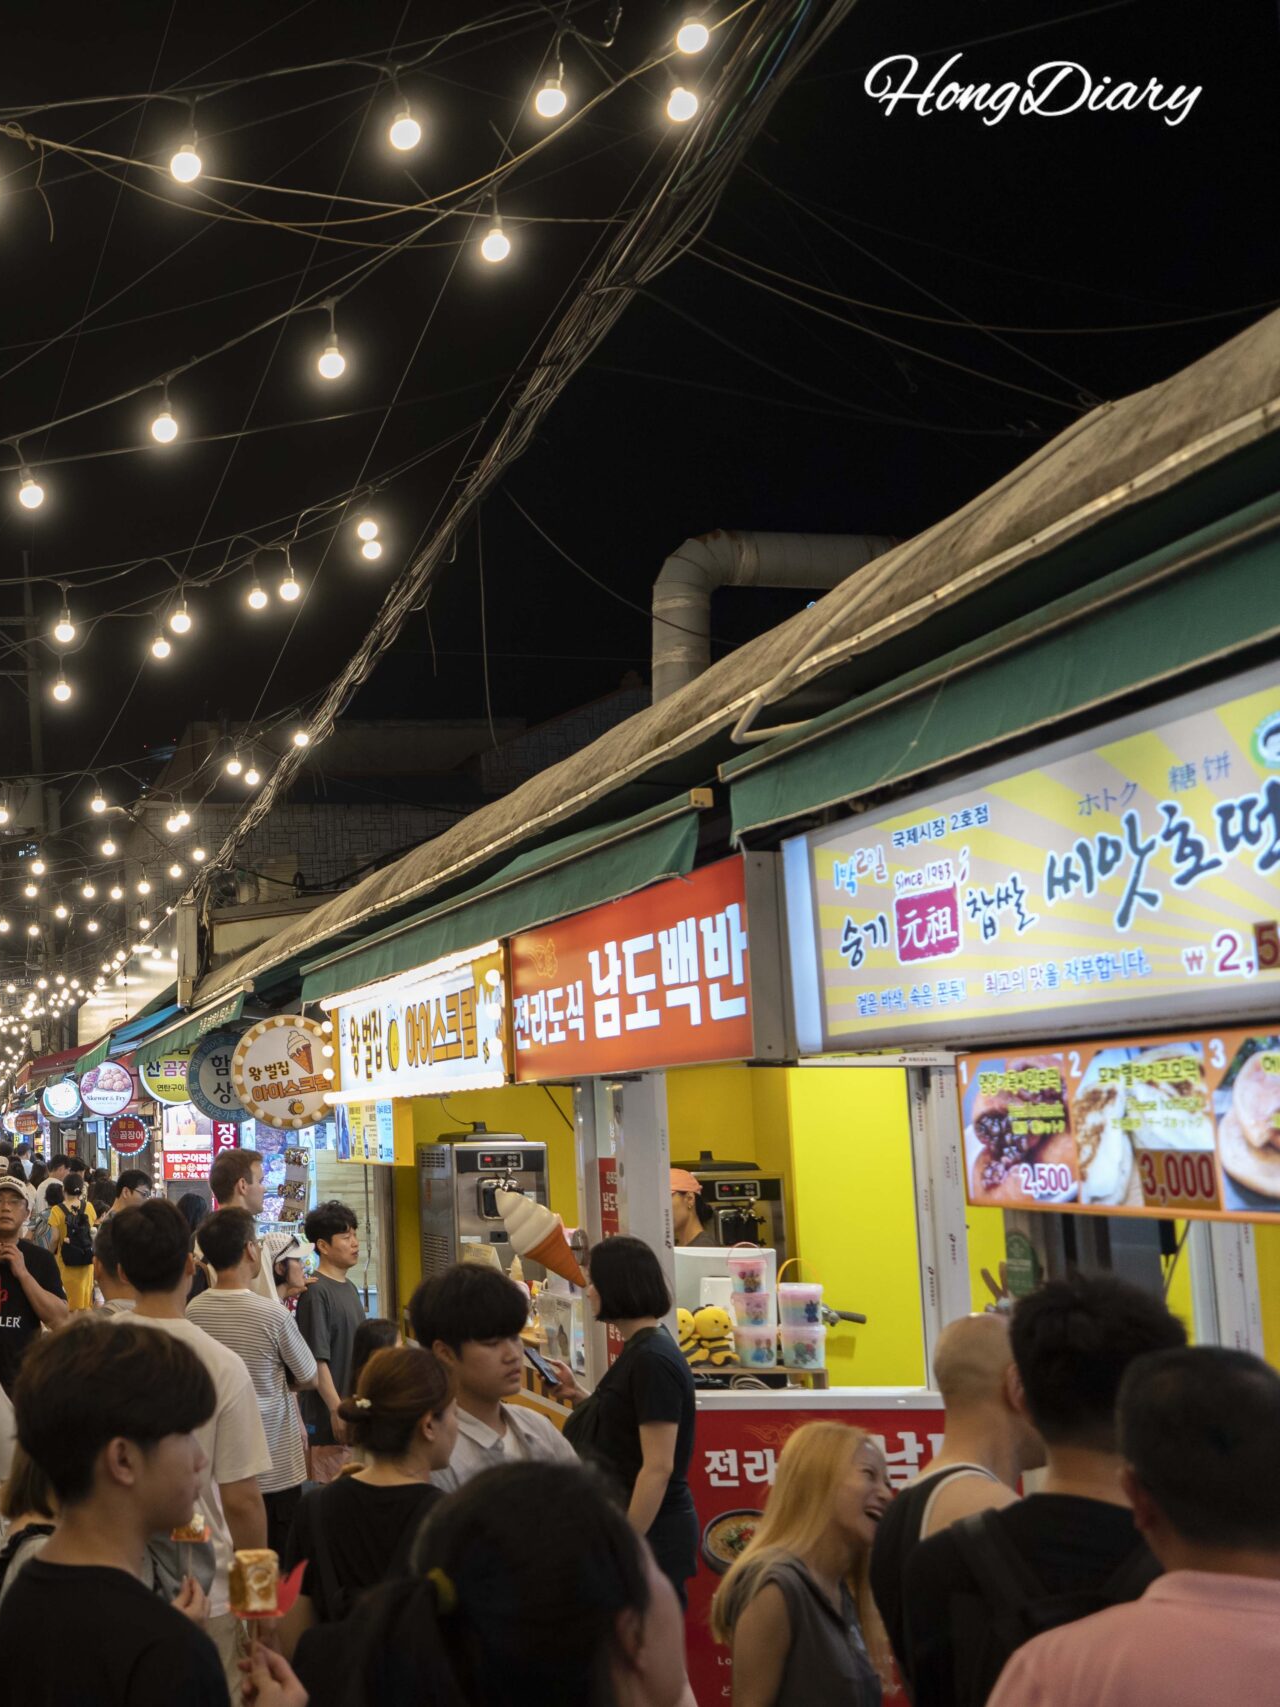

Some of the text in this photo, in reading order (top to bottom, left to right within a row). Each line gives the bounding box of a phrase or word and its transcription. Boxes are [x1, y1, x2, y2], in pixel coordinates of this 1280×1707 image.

[1077, 780, 1138, 816] ホトク
[892, 804, 990, 848] 국제시장 2호점
[927, 862, 951, 880] 1983
[841, 914, 889, 968] 승기
[901, 906, 958, 950] 元祖
[966, 875, 1036, 941] 찹쌀
[513, 902, 748, 1051] 전라도식 남도백반
[910, 984, 934, 1007] 속은
[985, 970, 1026, 994] 최고의
[1029, 966, 1058, 990] 맛을
[1065, 951, 1151, 984] 자부합니다.
[404, 985, 479, 1069] 아이스크림
[1068, 1051, 1082, 1078] 2
[1208, 1038, 1226, 1068] 3
[248, 1060, 289, 1082] 왕 벌집
[959, 1060, 968, 1085] 1
[157, 1083, 188, 1092] 연탄구이
[252, 1073, 332, 1102] 아이스크림
[1019, 1165, 1070, 1195] 2,500
[1139, 1153, 1215, 1204] 3,000
